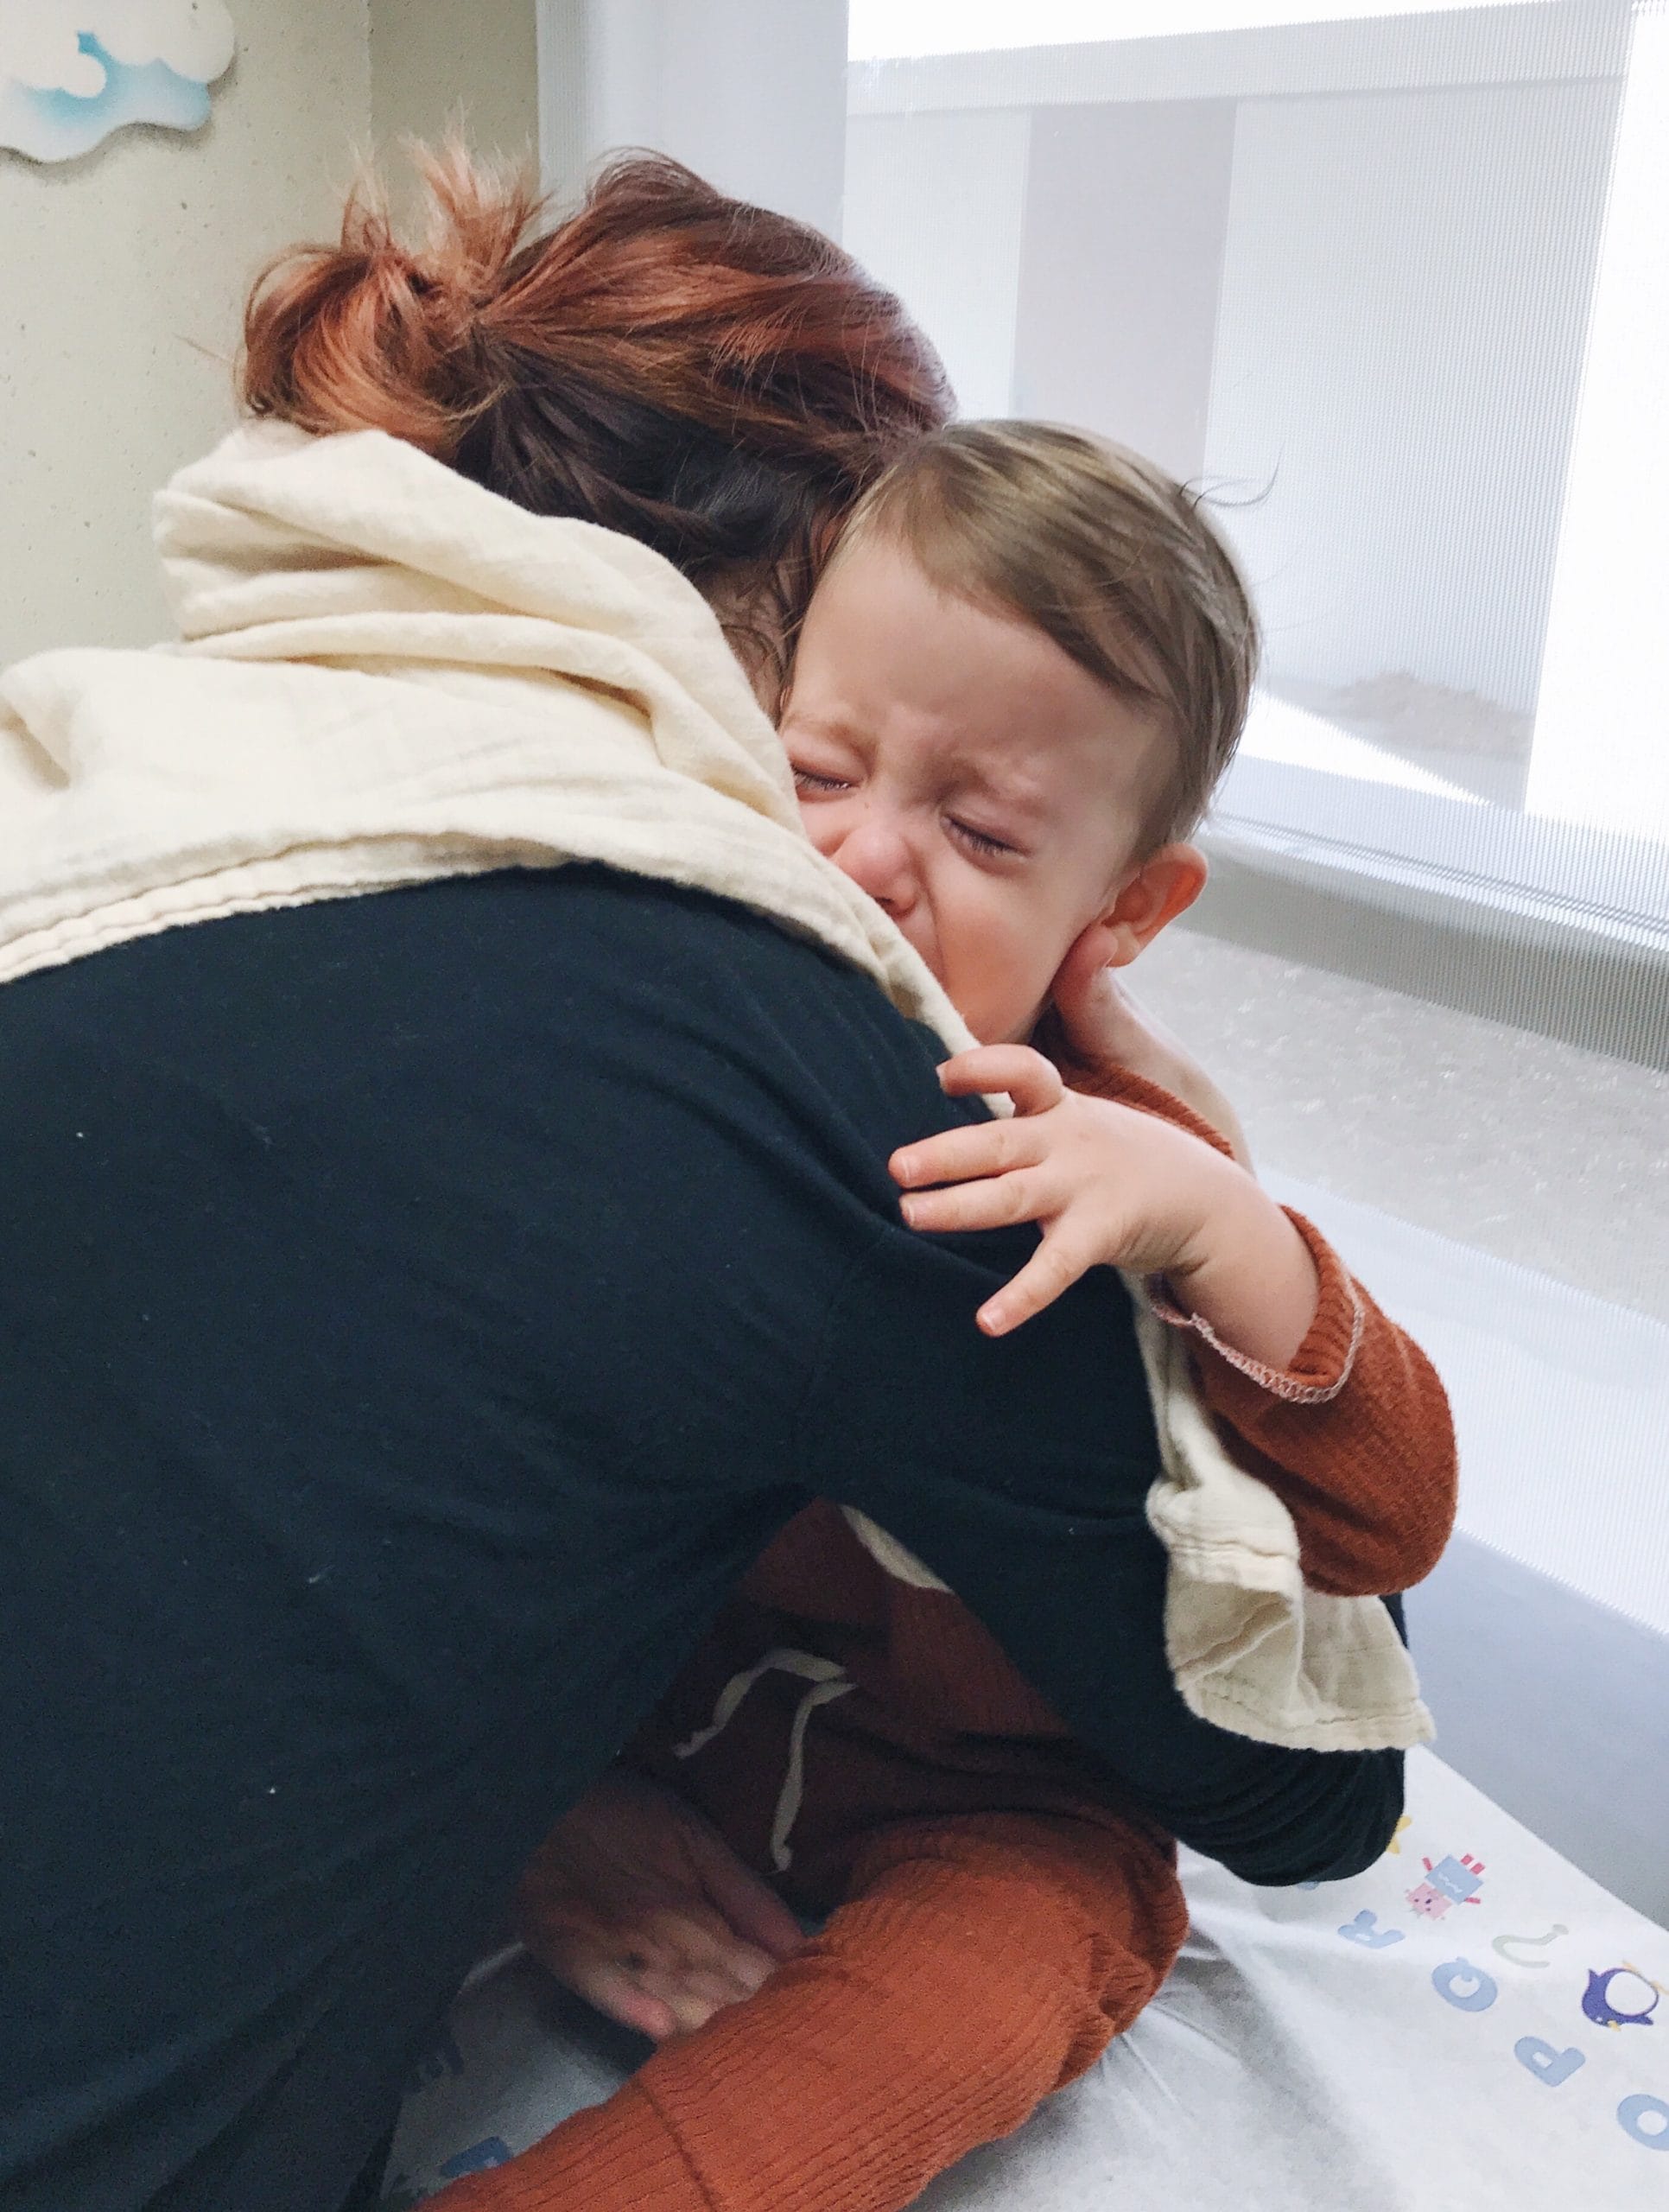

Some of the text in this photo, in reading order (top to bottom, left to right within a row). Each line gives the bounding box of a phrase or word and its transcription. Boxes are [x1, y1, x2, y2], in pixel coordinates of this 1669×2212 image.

[1336, 1908, 1669, 2150] O P Q R
